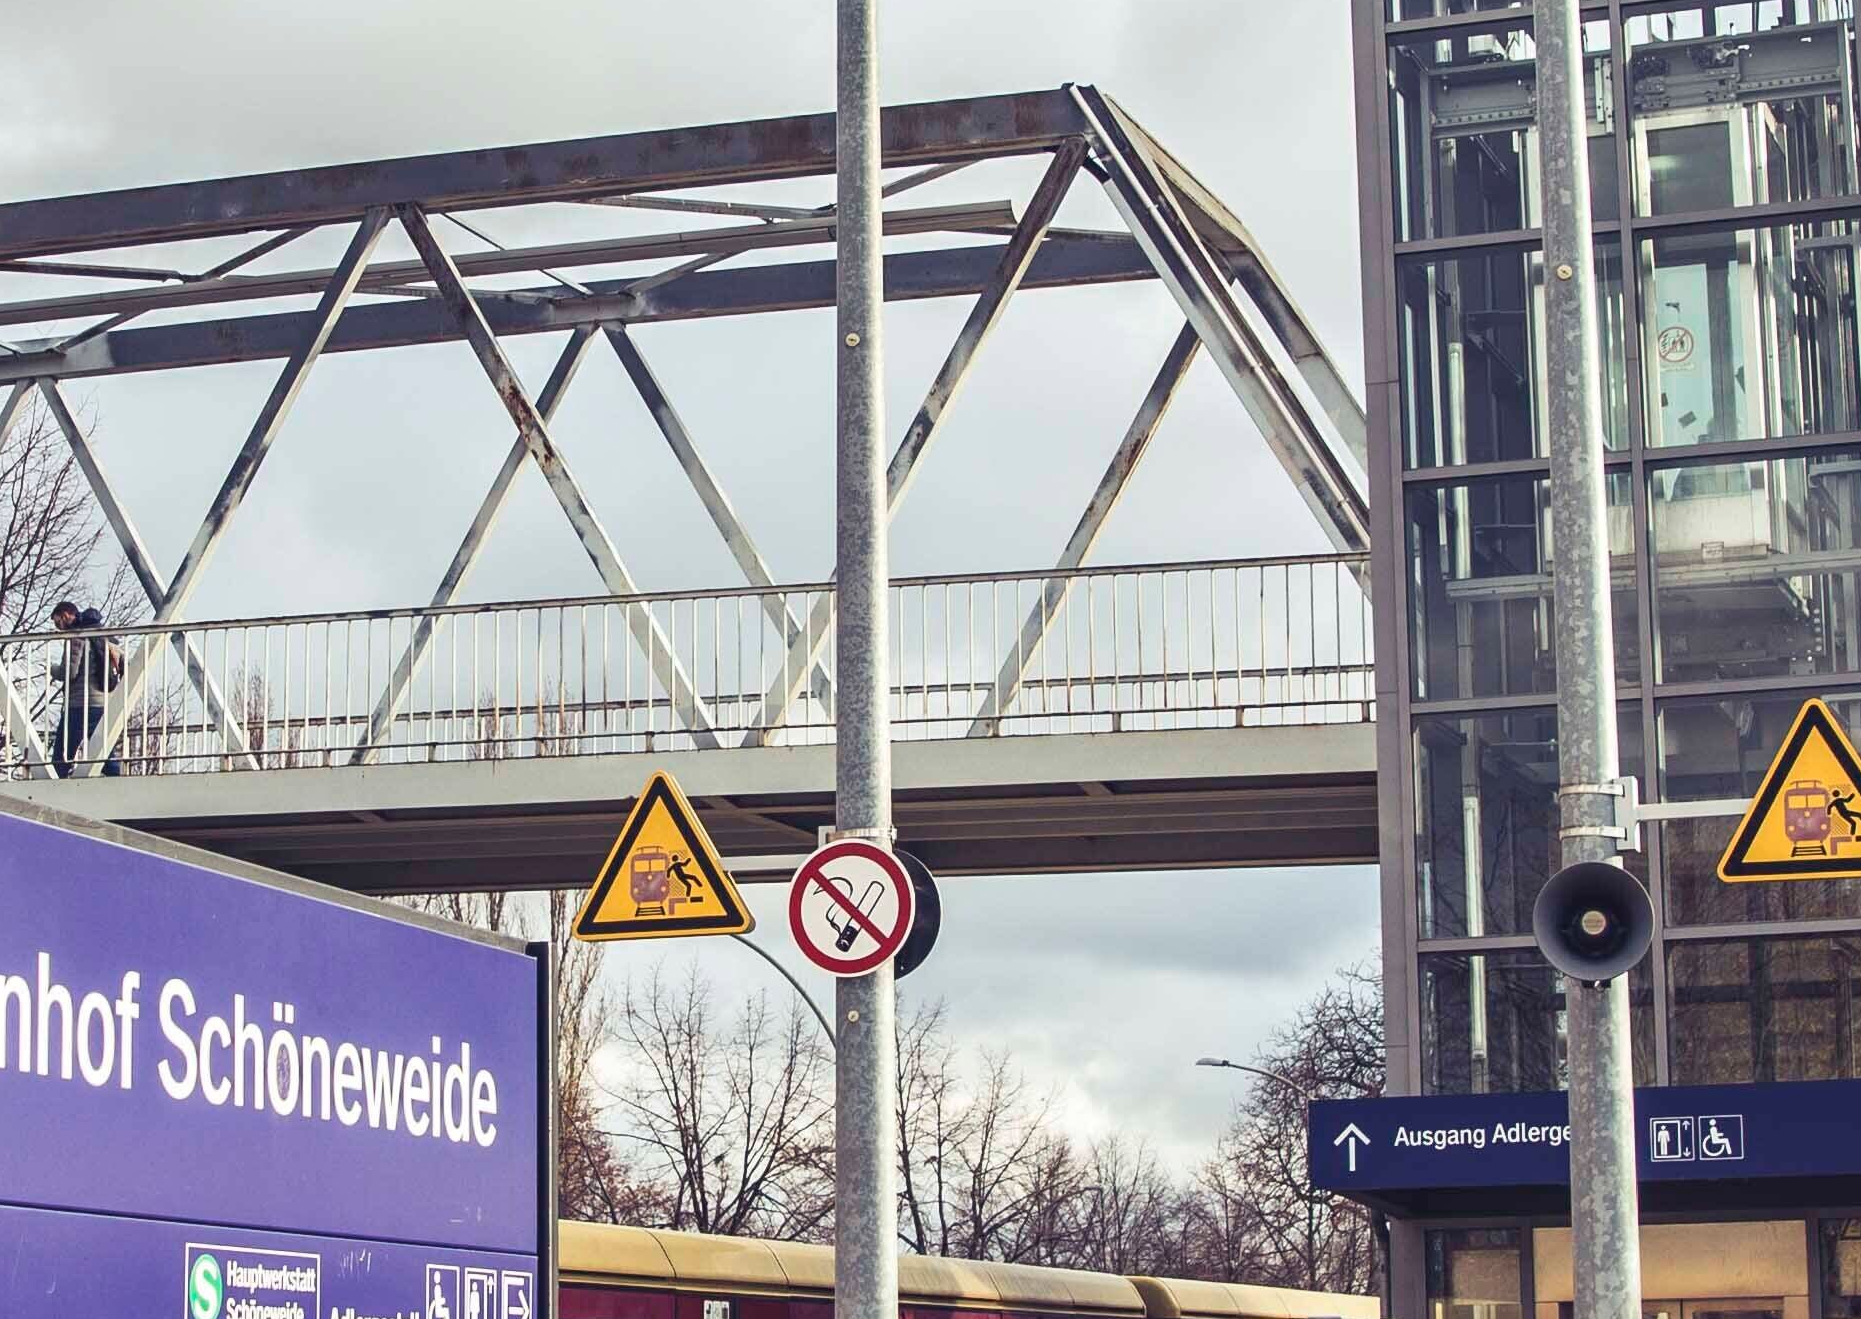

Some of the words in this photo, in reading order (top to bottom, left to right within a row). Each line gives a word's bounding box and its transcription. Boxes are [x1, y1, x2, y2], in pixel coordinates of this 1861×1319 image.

[157, 977, 498, 1148] Schöneweide
[1394, 1126, 1486, 1151] Ausgang
[1492, 1122, 1571, 1147] Adlerge
[226, 1260, 317, 1293] Hauptwerkstatt
